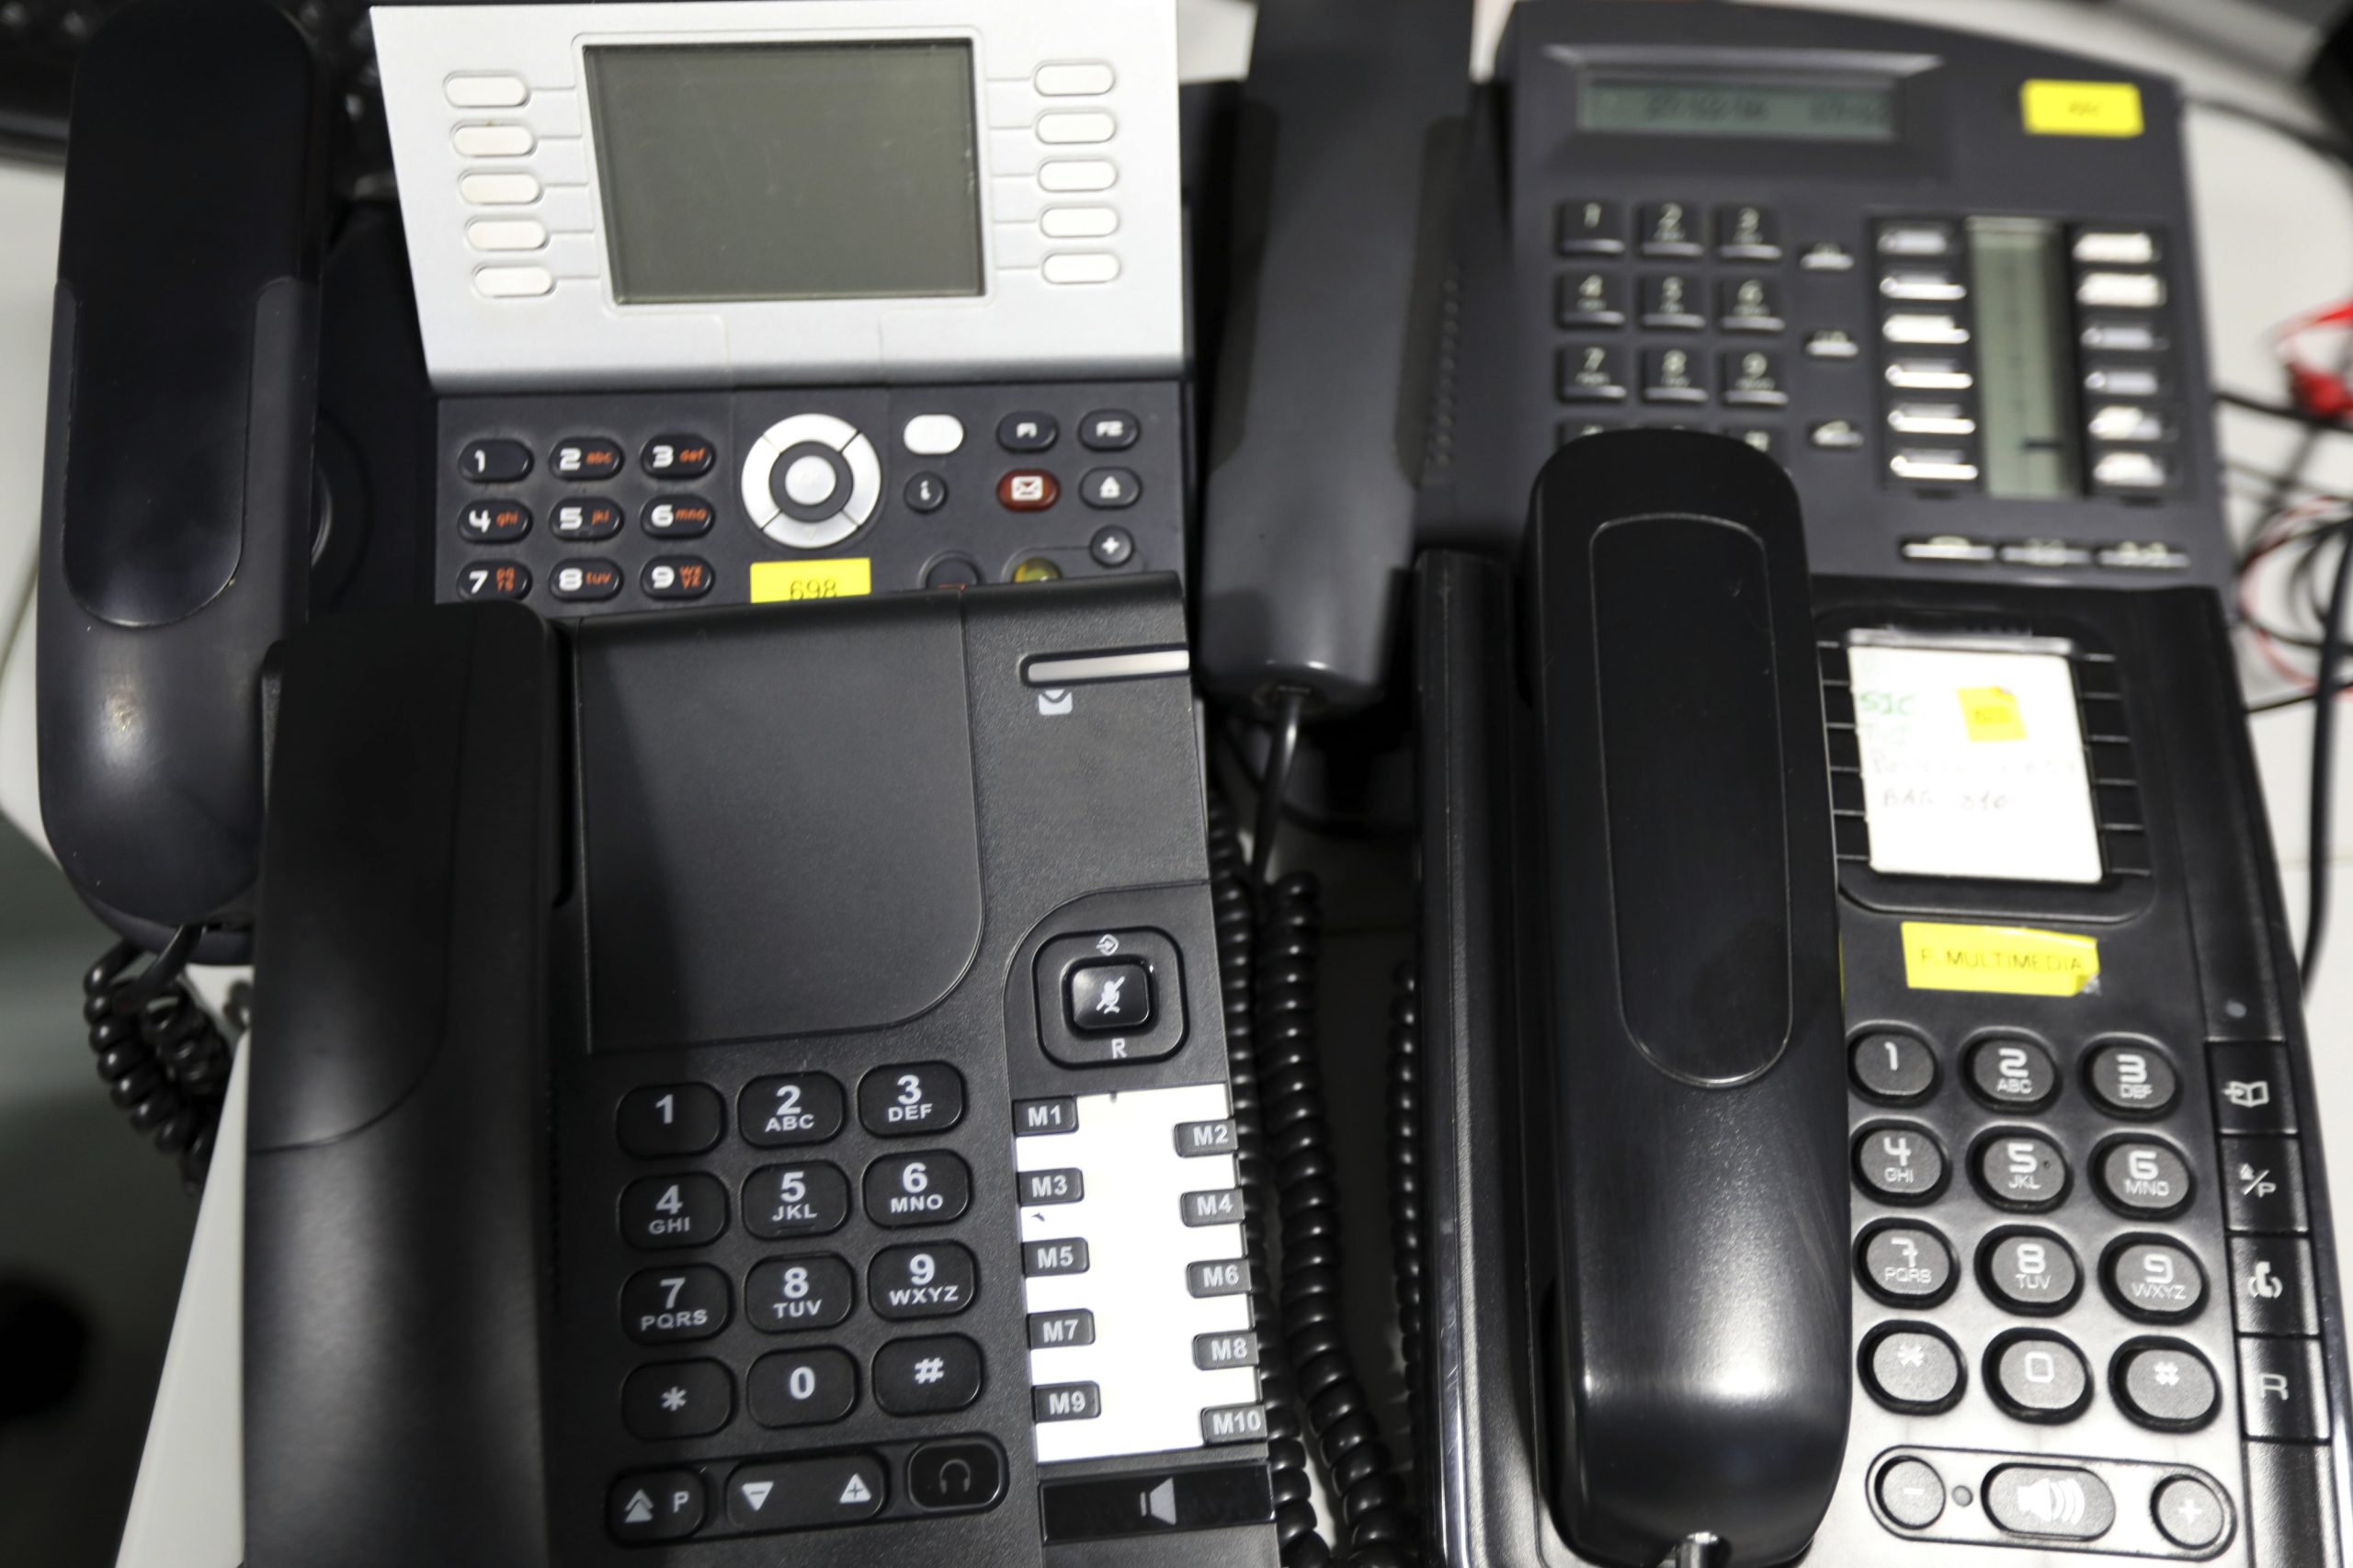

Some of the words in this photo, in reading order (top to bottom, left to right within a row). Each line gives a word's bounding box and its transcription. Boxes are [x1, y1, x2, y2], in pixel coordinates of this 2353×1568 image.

[1659, 202, 1683, 229] 2
[474, 449, 485, 473] 1
[560, 448, 582, 471] 2
[585, 451, 614, 464] abc
[653, 445, 674, 467] 3
[679, 449, 705, 464] def
[469, 510, 490, 532] 4
[495, 509, 519, 528] ghi
[560, 507, 582, 529] 5
[651, 505, 673, 528] 6
[676, 508, 705, 522] mno
[469, 570, 488, 594] 7
[559, 568, 583, 590] 8
[585, 571, 612, 585] tuv
[651, 565, 674, 588] 9
[790, 579, 837, 599] 698
[1947, 950, 2082, 971] MULTIMEDIA
[1111, 1039, 1128, 1059] R
[1884, 1042, 1897, 1071] 1
[1998, 1048, 2029, 1078] 2
[2118, 1054, 2145, 1083] 3
[897, 1074, 921, 1104] 3
[1996, 1078, 2032, 1095] ABC
[2120, 1084, 2153, 1099] DEF
[655, 1095, 673, 1123] 1
[777, 1085, 801, 1115] 2
[765, 1114, 814, 1132] ABC
[888, 1104, 933, 1122] DEF
[1028, 1105, 1061, 1128] M1
[1193, 1125, 1228, 1146] M2
[1883, 1138, 1911, 1166] 4
[2009, 1143, 2036, 1173] 5
[1885, 1167, 1914, 1183] GHI
[2129, 1151, 2157, 1179] 6
[780, 1172, 806, 1202] 5
[904, 1162, 927, 1193] 6
[1032, 1176, 1067, 1198] M3
[2009, 1174, 2040, 1189] JKL
[2125, 1180, 2169, 1196] MNO
[655, 1185, 682, 1214] 4
[891, 1194, 943, 1212] MNO
[1197, 1194, 1233, 1216] M4
[772, 1204, 817, 1221] JKL
[649, 1217, 689, 1234] GHI
[1038, 1245, 1074, 1268] M5
[1891, 1238, 1916, 1267] 7
[2016, 1244, 2046, 1274] 8
[909, 1254, 935, 1285] 9
[1203, 1265, 1239, 1287] M6
[2143, 1254, 2173, 1283] 9
[784, 1267, 809, 1299] 8
[2016, 1274, 2051, 1290] TUV
[2131, 1283, 2188, 1301] WXYZ
[660, 1278, 686, 1310] 7
[889, 1285, 958, 1305] WXYZ
[641, 1309, 708, 1331] PQRS
[773, 1299, 822, 1319] TUV
[1043, 1319, 1078, 1341] M7
[1211, 1338, 1247, 1360] M8
[2025, 1351, 2054, 1383] 0
[790, 1366, 814, 1400] 0
[2261, 1373, 2289, 1400] R
[1050, 1392, 1086, 1415] M9
[1212, 1412, 1261, 1435] M10
[674, 1491, 689, 1513] P
